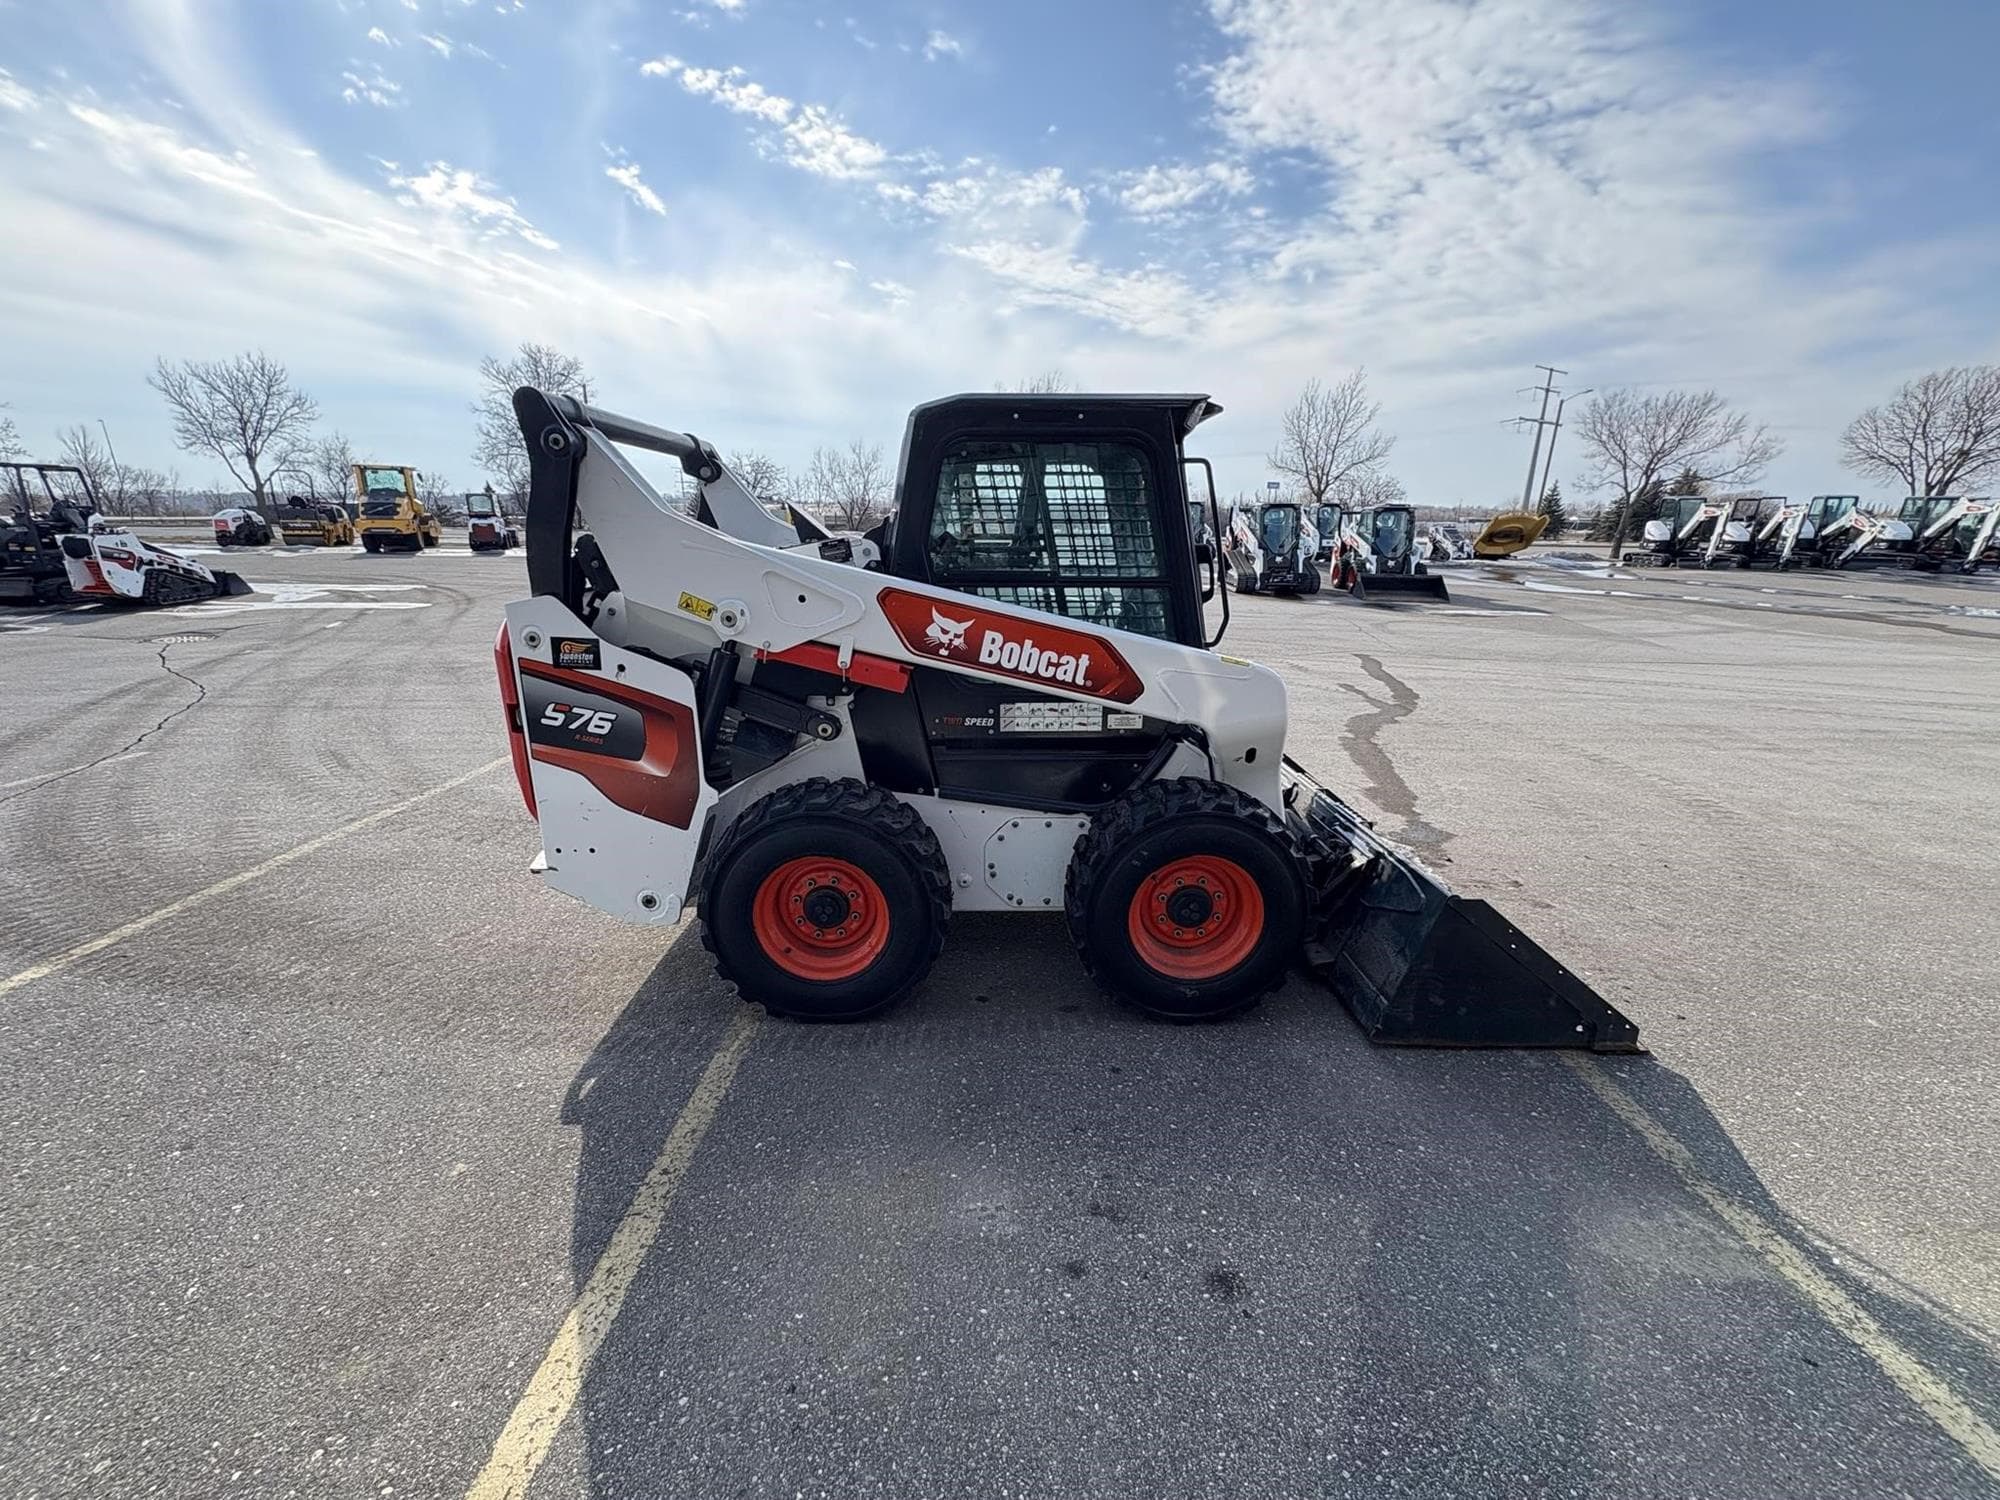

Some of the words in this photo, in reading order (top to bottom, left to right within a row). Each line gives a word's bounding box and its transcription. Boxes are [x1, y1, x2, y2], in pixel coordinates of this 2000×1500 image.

[979, 630, 1089, 686] Bobcat
[541, 703, 618, 735] S76
[964, 717, 995, 726] SPEED
